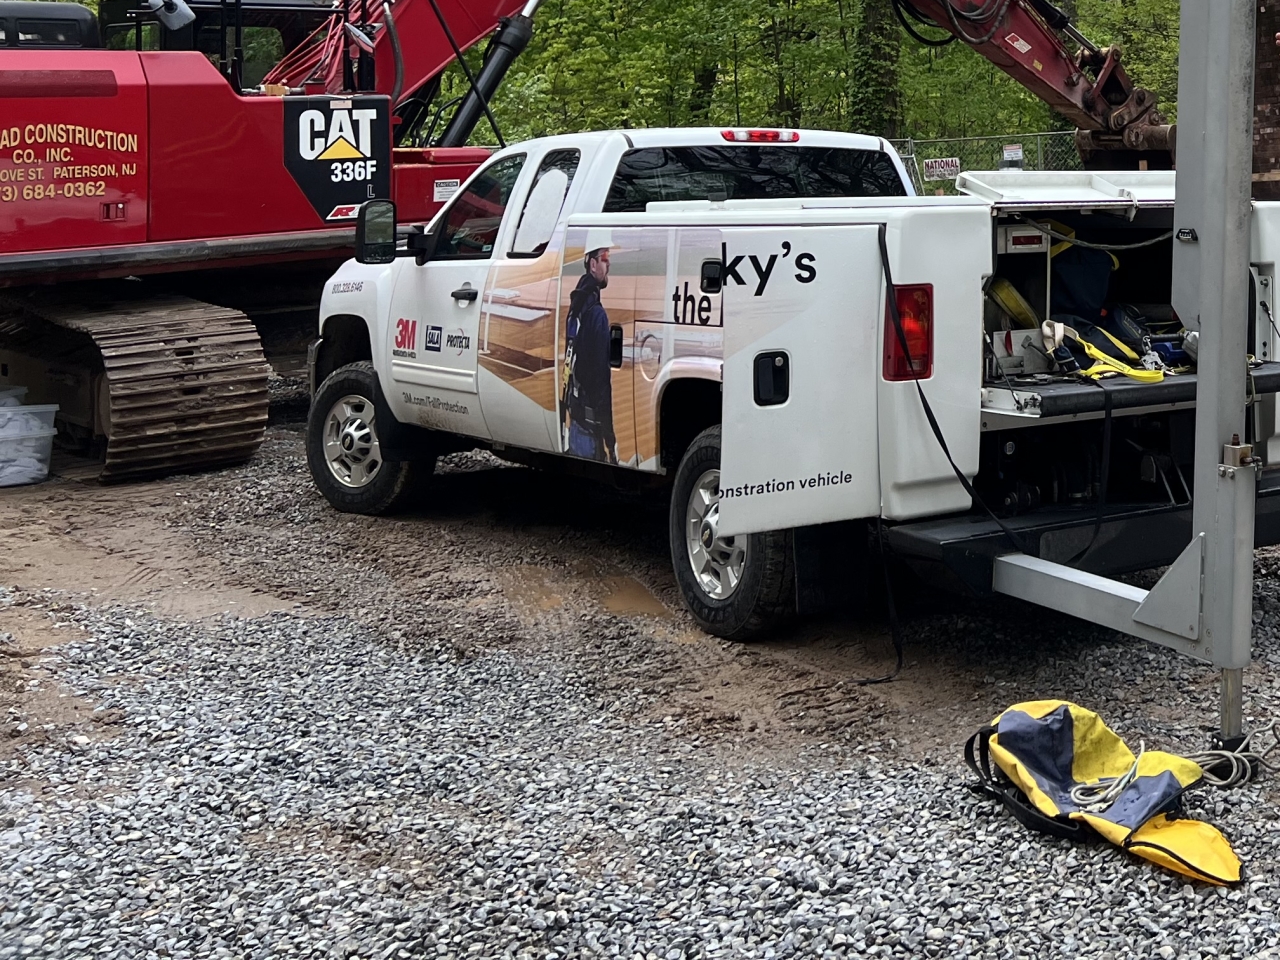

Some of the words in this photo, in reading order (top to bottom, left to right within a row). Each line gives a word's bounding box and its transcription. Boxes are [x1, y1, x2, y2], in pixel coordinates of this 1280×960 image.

[24, 123, 138, 153] CONSTRUCTION
[299, 108, 377, 160] CAT
[13, 149, 42, 165] CO.,
[45, 147, 74, 162] INC.
[924, 159, 959, 170] NATIONAL
[28, 167, 45, 180] ST.
[53, 164, 119, 179] PATERSON,
[121, 163, 137, 176] NJ
[330, 160, 377, 182] 336F
[0, 185, 18, 201] 3)
[23, 181, 106, 200] 684-0362
[672, 281, 712, 326] the
[395, 317, 417, 351] 3M
[427, 330, 440, 346] SALA
[446, 333, 471, 350] PROTECTA
[799, 470, 853, 489] vehicle
